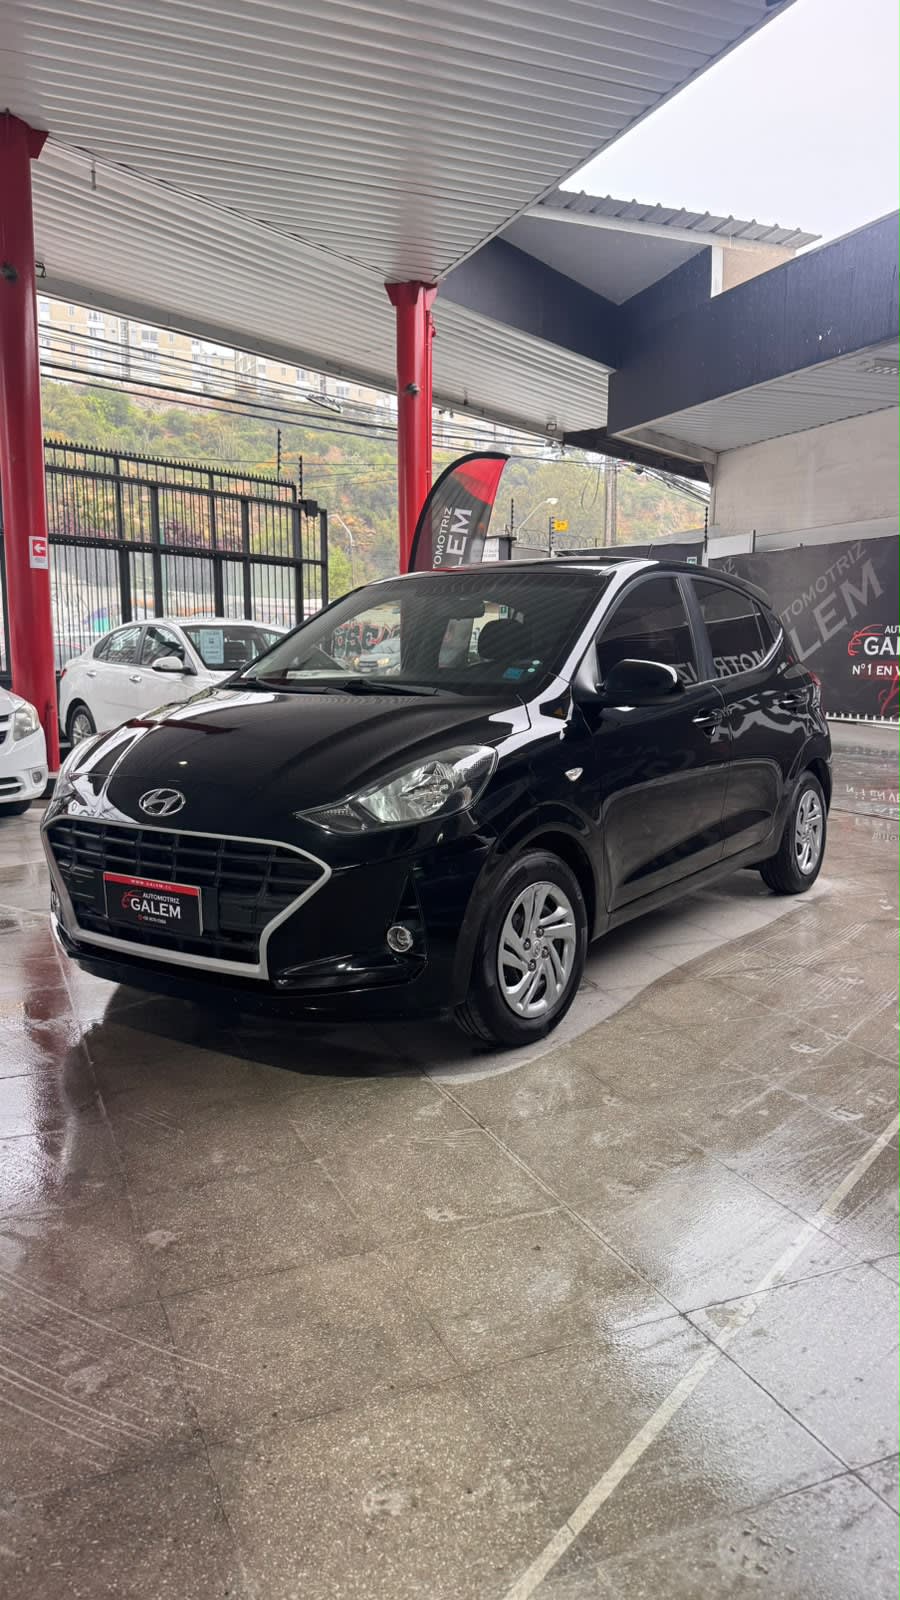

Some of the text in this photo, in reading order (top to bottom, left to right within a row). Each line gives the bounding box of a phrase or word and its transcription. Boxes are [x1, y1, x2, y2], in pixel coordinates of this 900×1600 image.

[789, 558, 884, 662] LEM
[876, 665, 893, 676] EN
[142, 892, 180, 905] AUTOMOTRIZ
[130, 898, 181, 920] GALEM
